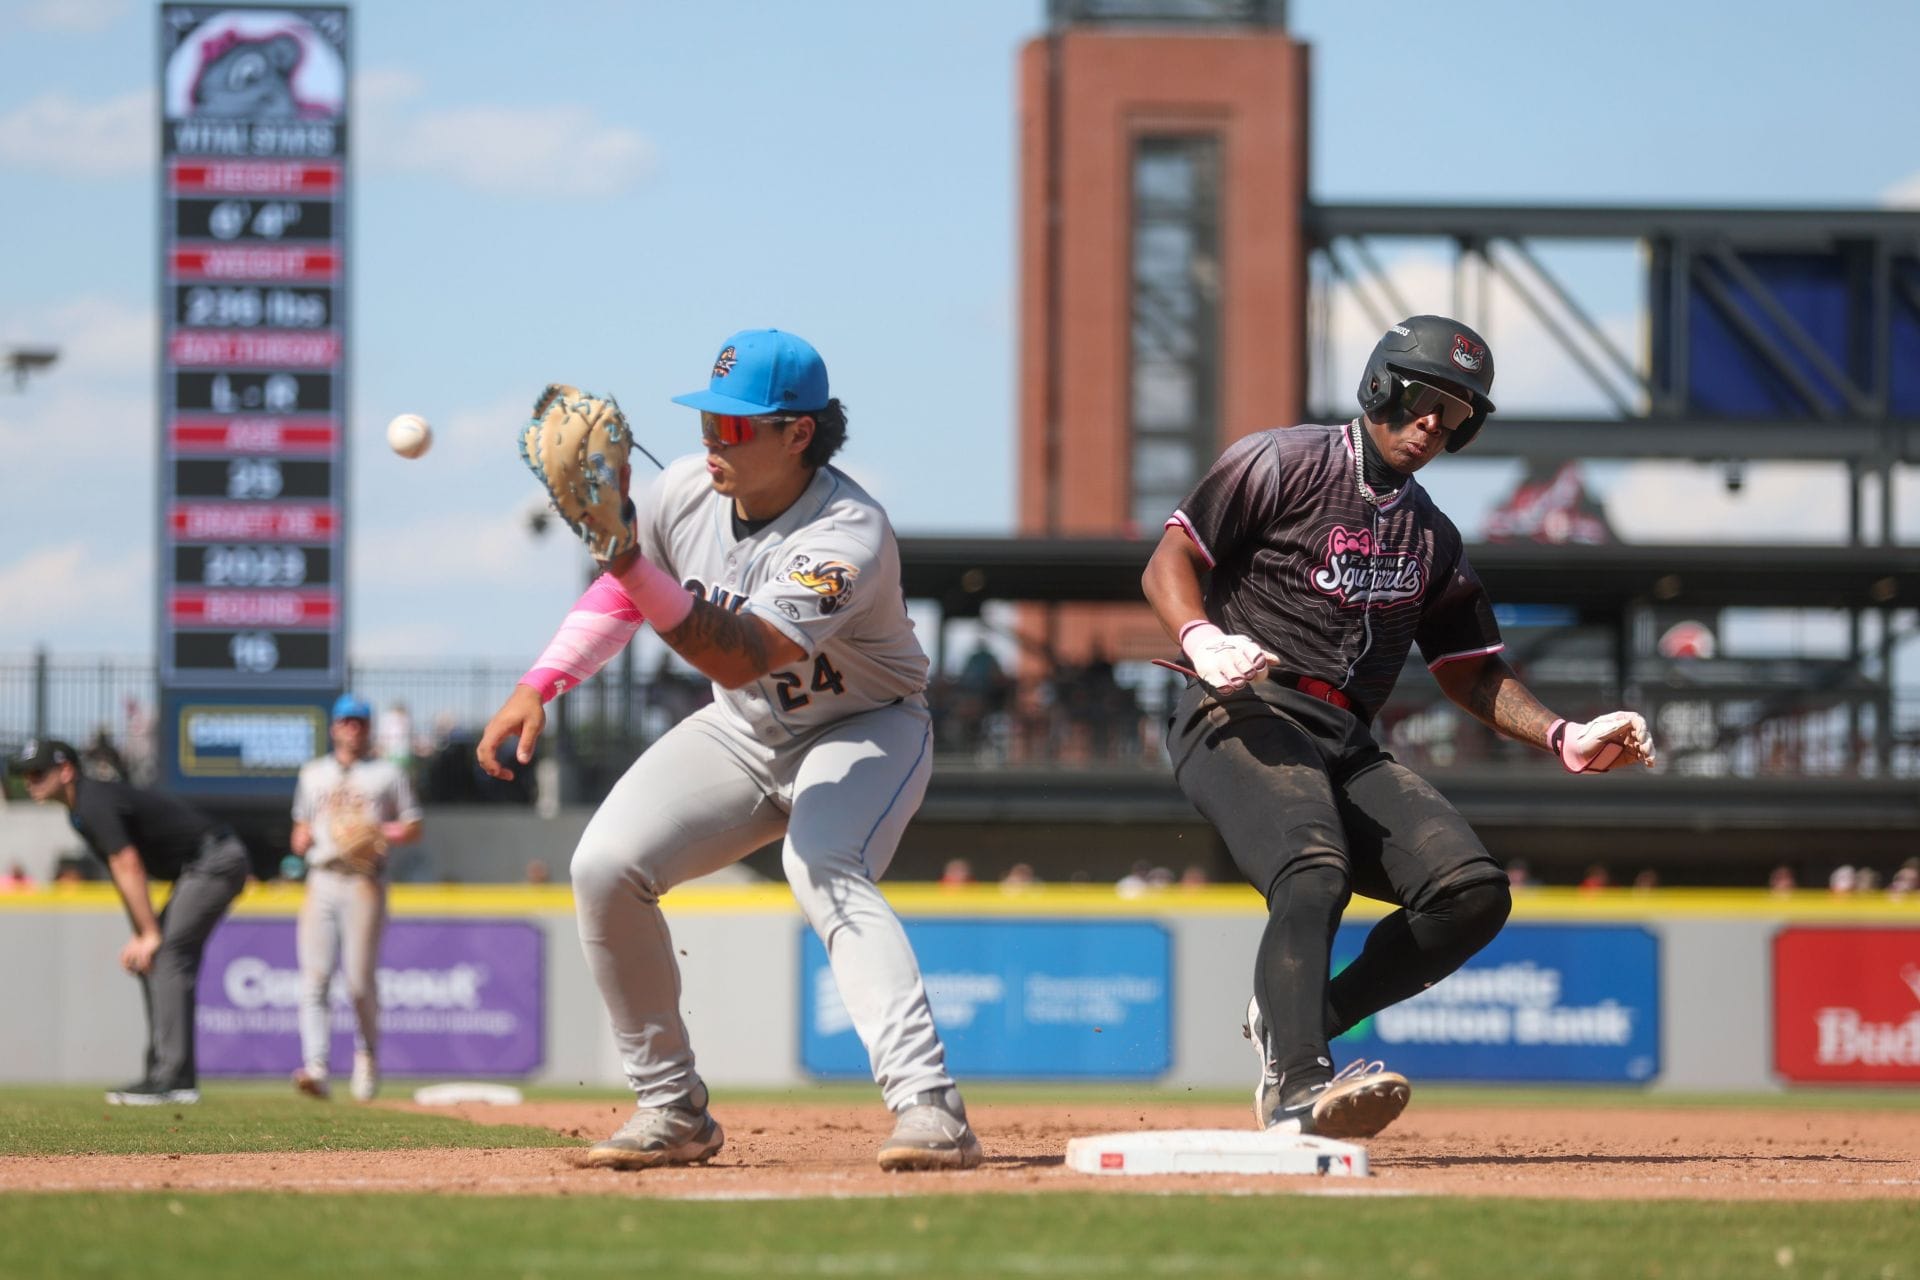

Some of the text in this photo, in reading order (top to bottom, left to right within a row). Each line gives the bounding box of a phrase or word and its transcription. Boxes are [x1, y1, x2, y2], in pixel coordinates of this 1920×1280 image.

[265, 288, 326, 328] lbs
[212, 374, 239, 413] L
[204, 546, 305, 586] 2023
[769, 652, 845, 712] 24
[1376, 1000, 1632, 1045] Union Bank
